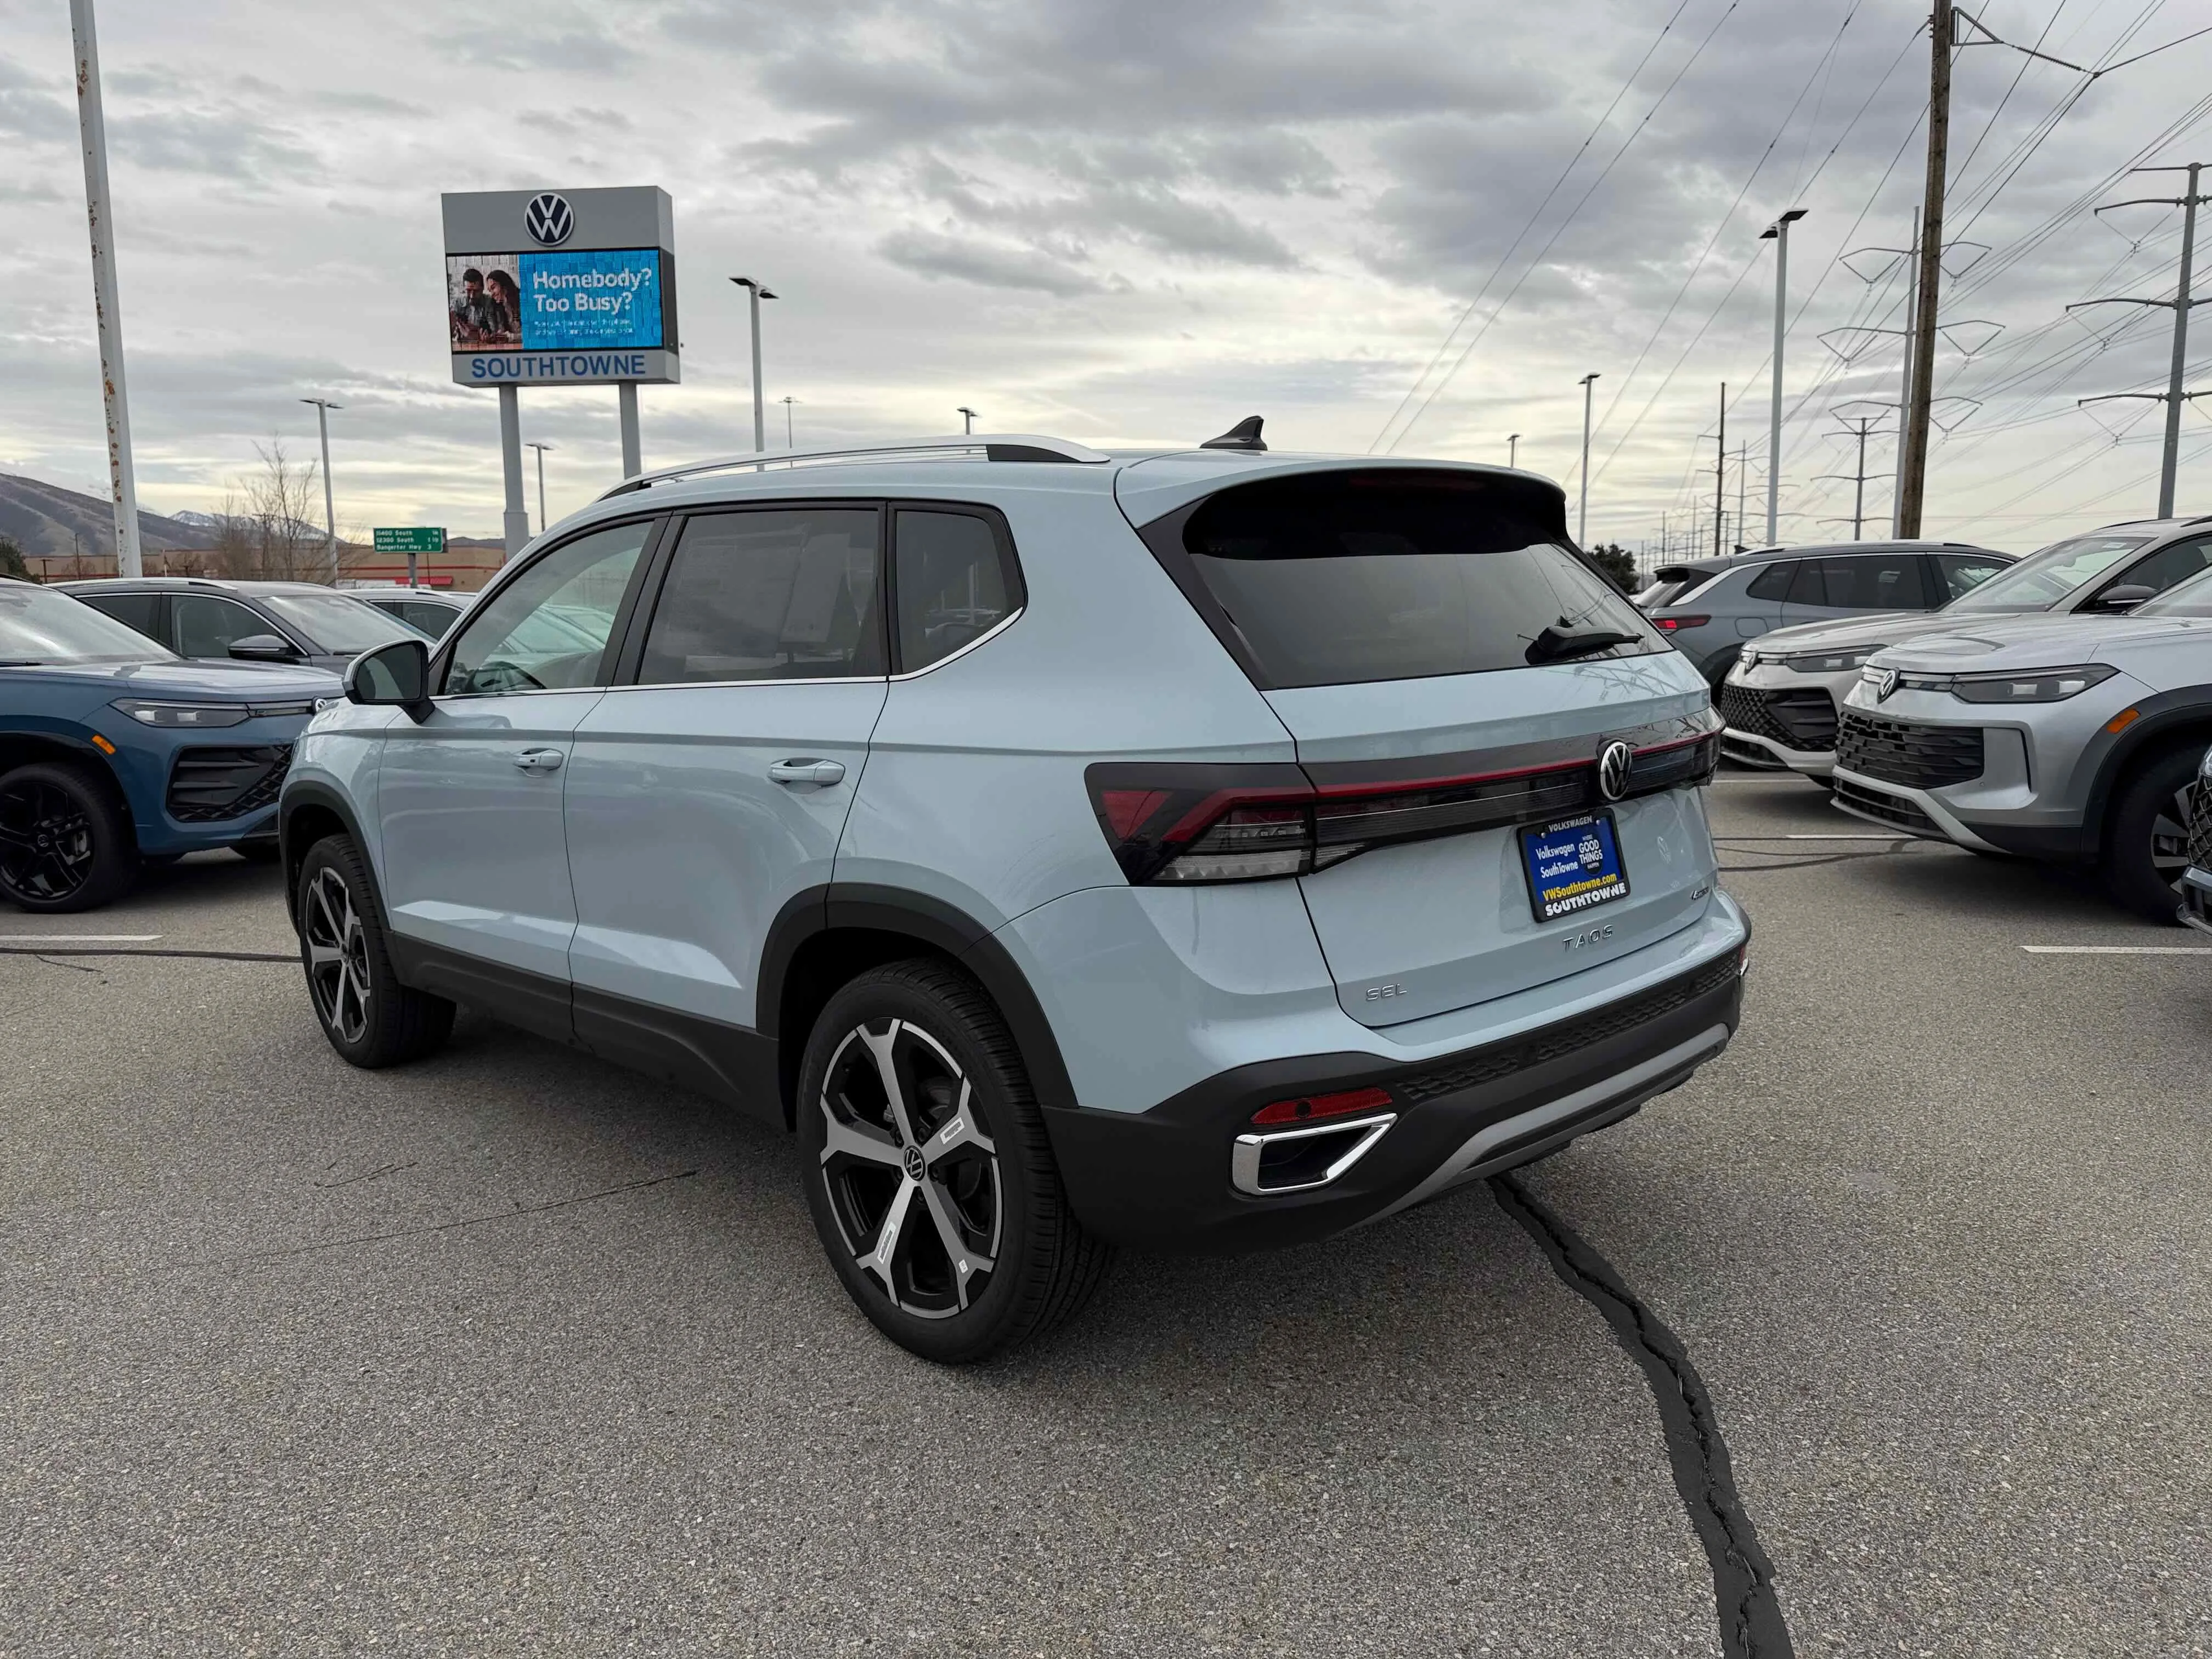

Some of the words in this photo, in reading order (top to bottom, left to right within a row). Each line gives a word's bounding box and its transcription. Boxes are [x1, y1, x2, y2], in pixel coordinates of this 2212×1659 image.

[533, 267, 652, 290] Homebody?
[533, 294, 569, 312] Too
[574, 292, 632, 315] Busy?
[472, 355, 646, 378] SOUTHTOWNE
[1548, 815, 1592, 833] VOLKSWAGEN
[1536, 843, 1575, 860] Volkswagen
[1579, 839, 1599, 854] GOOD
[1579, 849, 1603, 864] THINGS
[1541, 861, 1578, 878] SouthTowne
[1543, 873, 1617, 901] VWSouthtowne.com
[1545, 882, 1626, 916] SOUTHTOWNE
[1562, 924, 1613, 952] TAOS
[1365, 984, 1408, 1001] SEL
